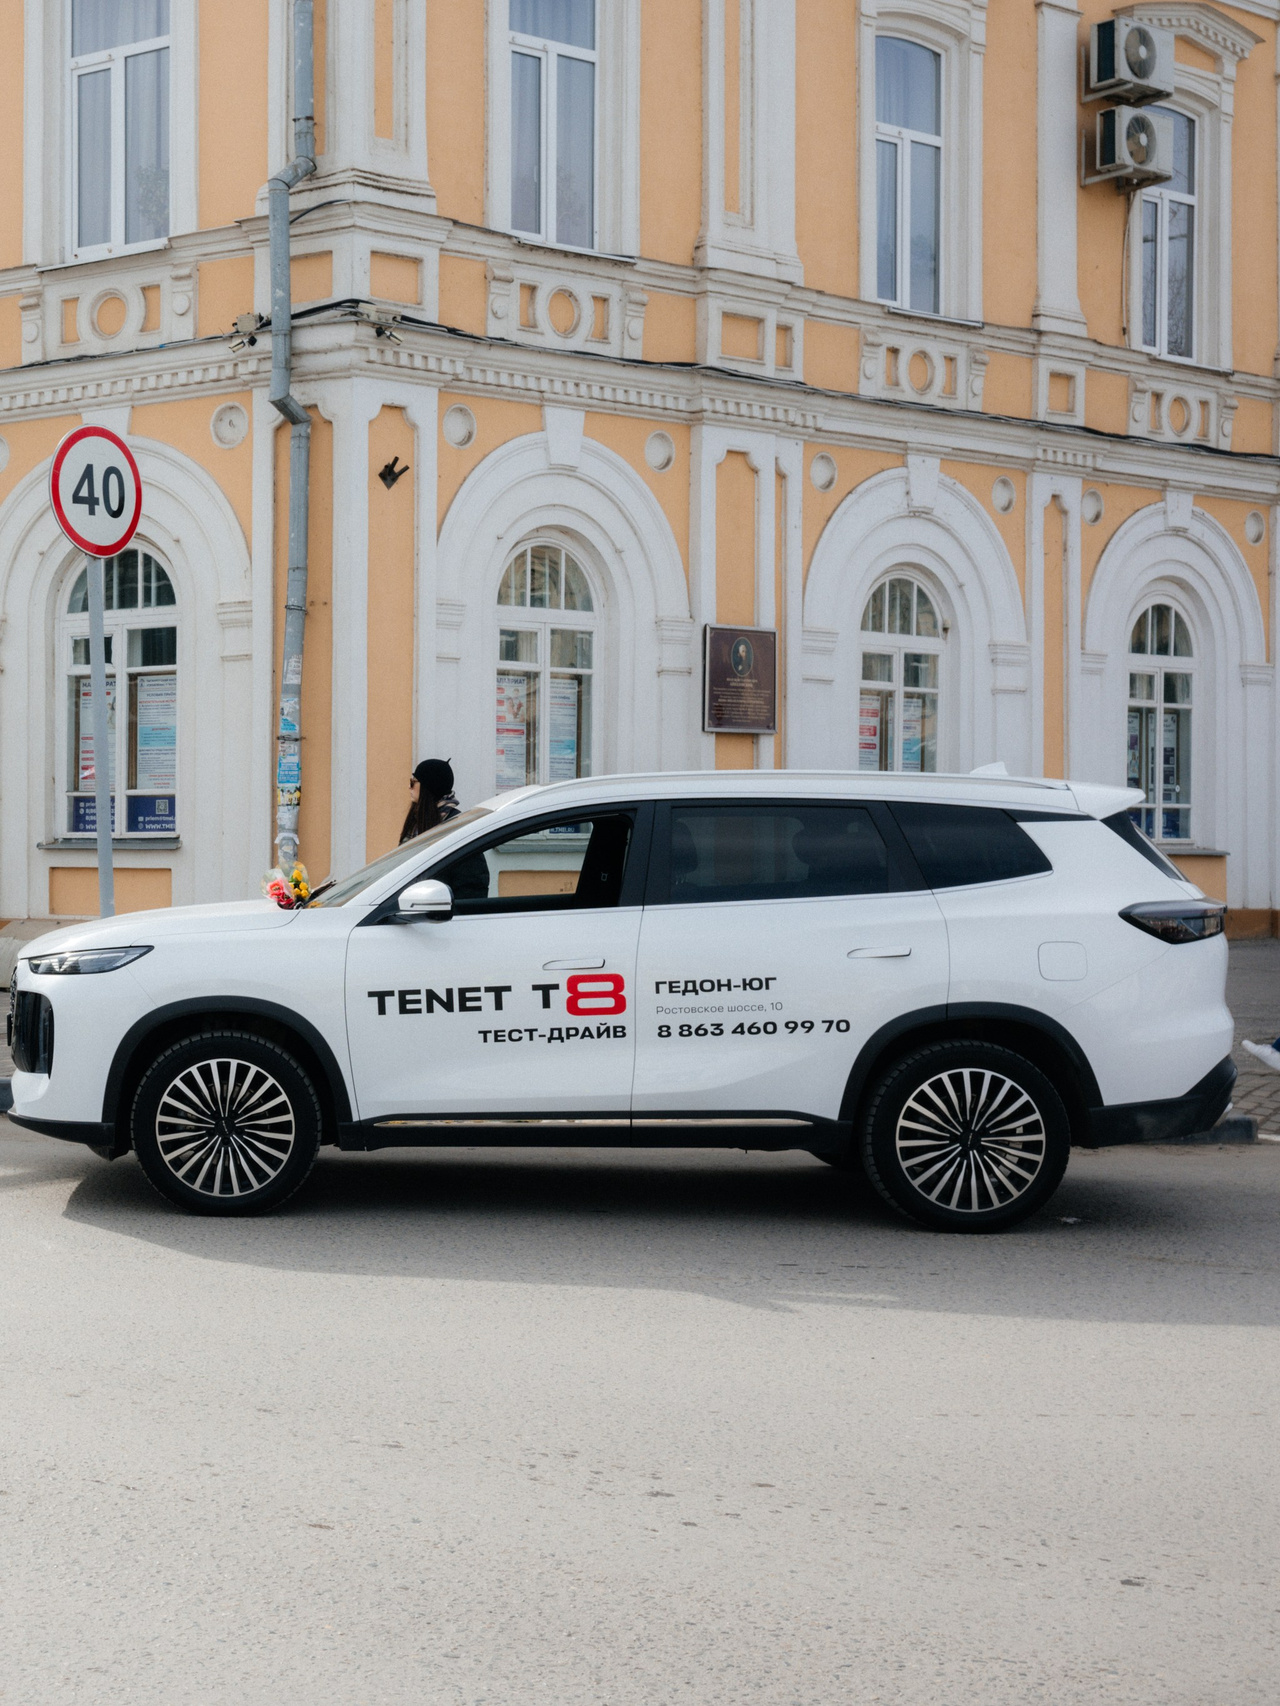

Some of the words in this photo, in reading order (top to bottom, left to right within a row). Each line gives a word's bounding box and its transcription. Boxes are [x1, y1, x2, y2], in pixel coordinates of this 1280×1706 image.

[72, 463, 125, 519] 40
[367, 985, 512, 1016] TENET
[531, 973, 627, 1016] T8
[655, 977, 777, 996] ГЕДОН-ЮГ
[656, 1005, 724, 1015] Ростовское
[727, 1003, 767, 1013] шоссе,
[770, 1001, 783, 1011] 10
[478, 1022, 627, 1044] ТЕСТ-ДРАЙВ
[657, 1024, 672, 1038] 8
[678, 1023, 724, 1037] 863
[731, 1021, 777, 1035] 460
[784, 1020, 815, 1034] 99
[821, 1019, 851, 1033] 70
